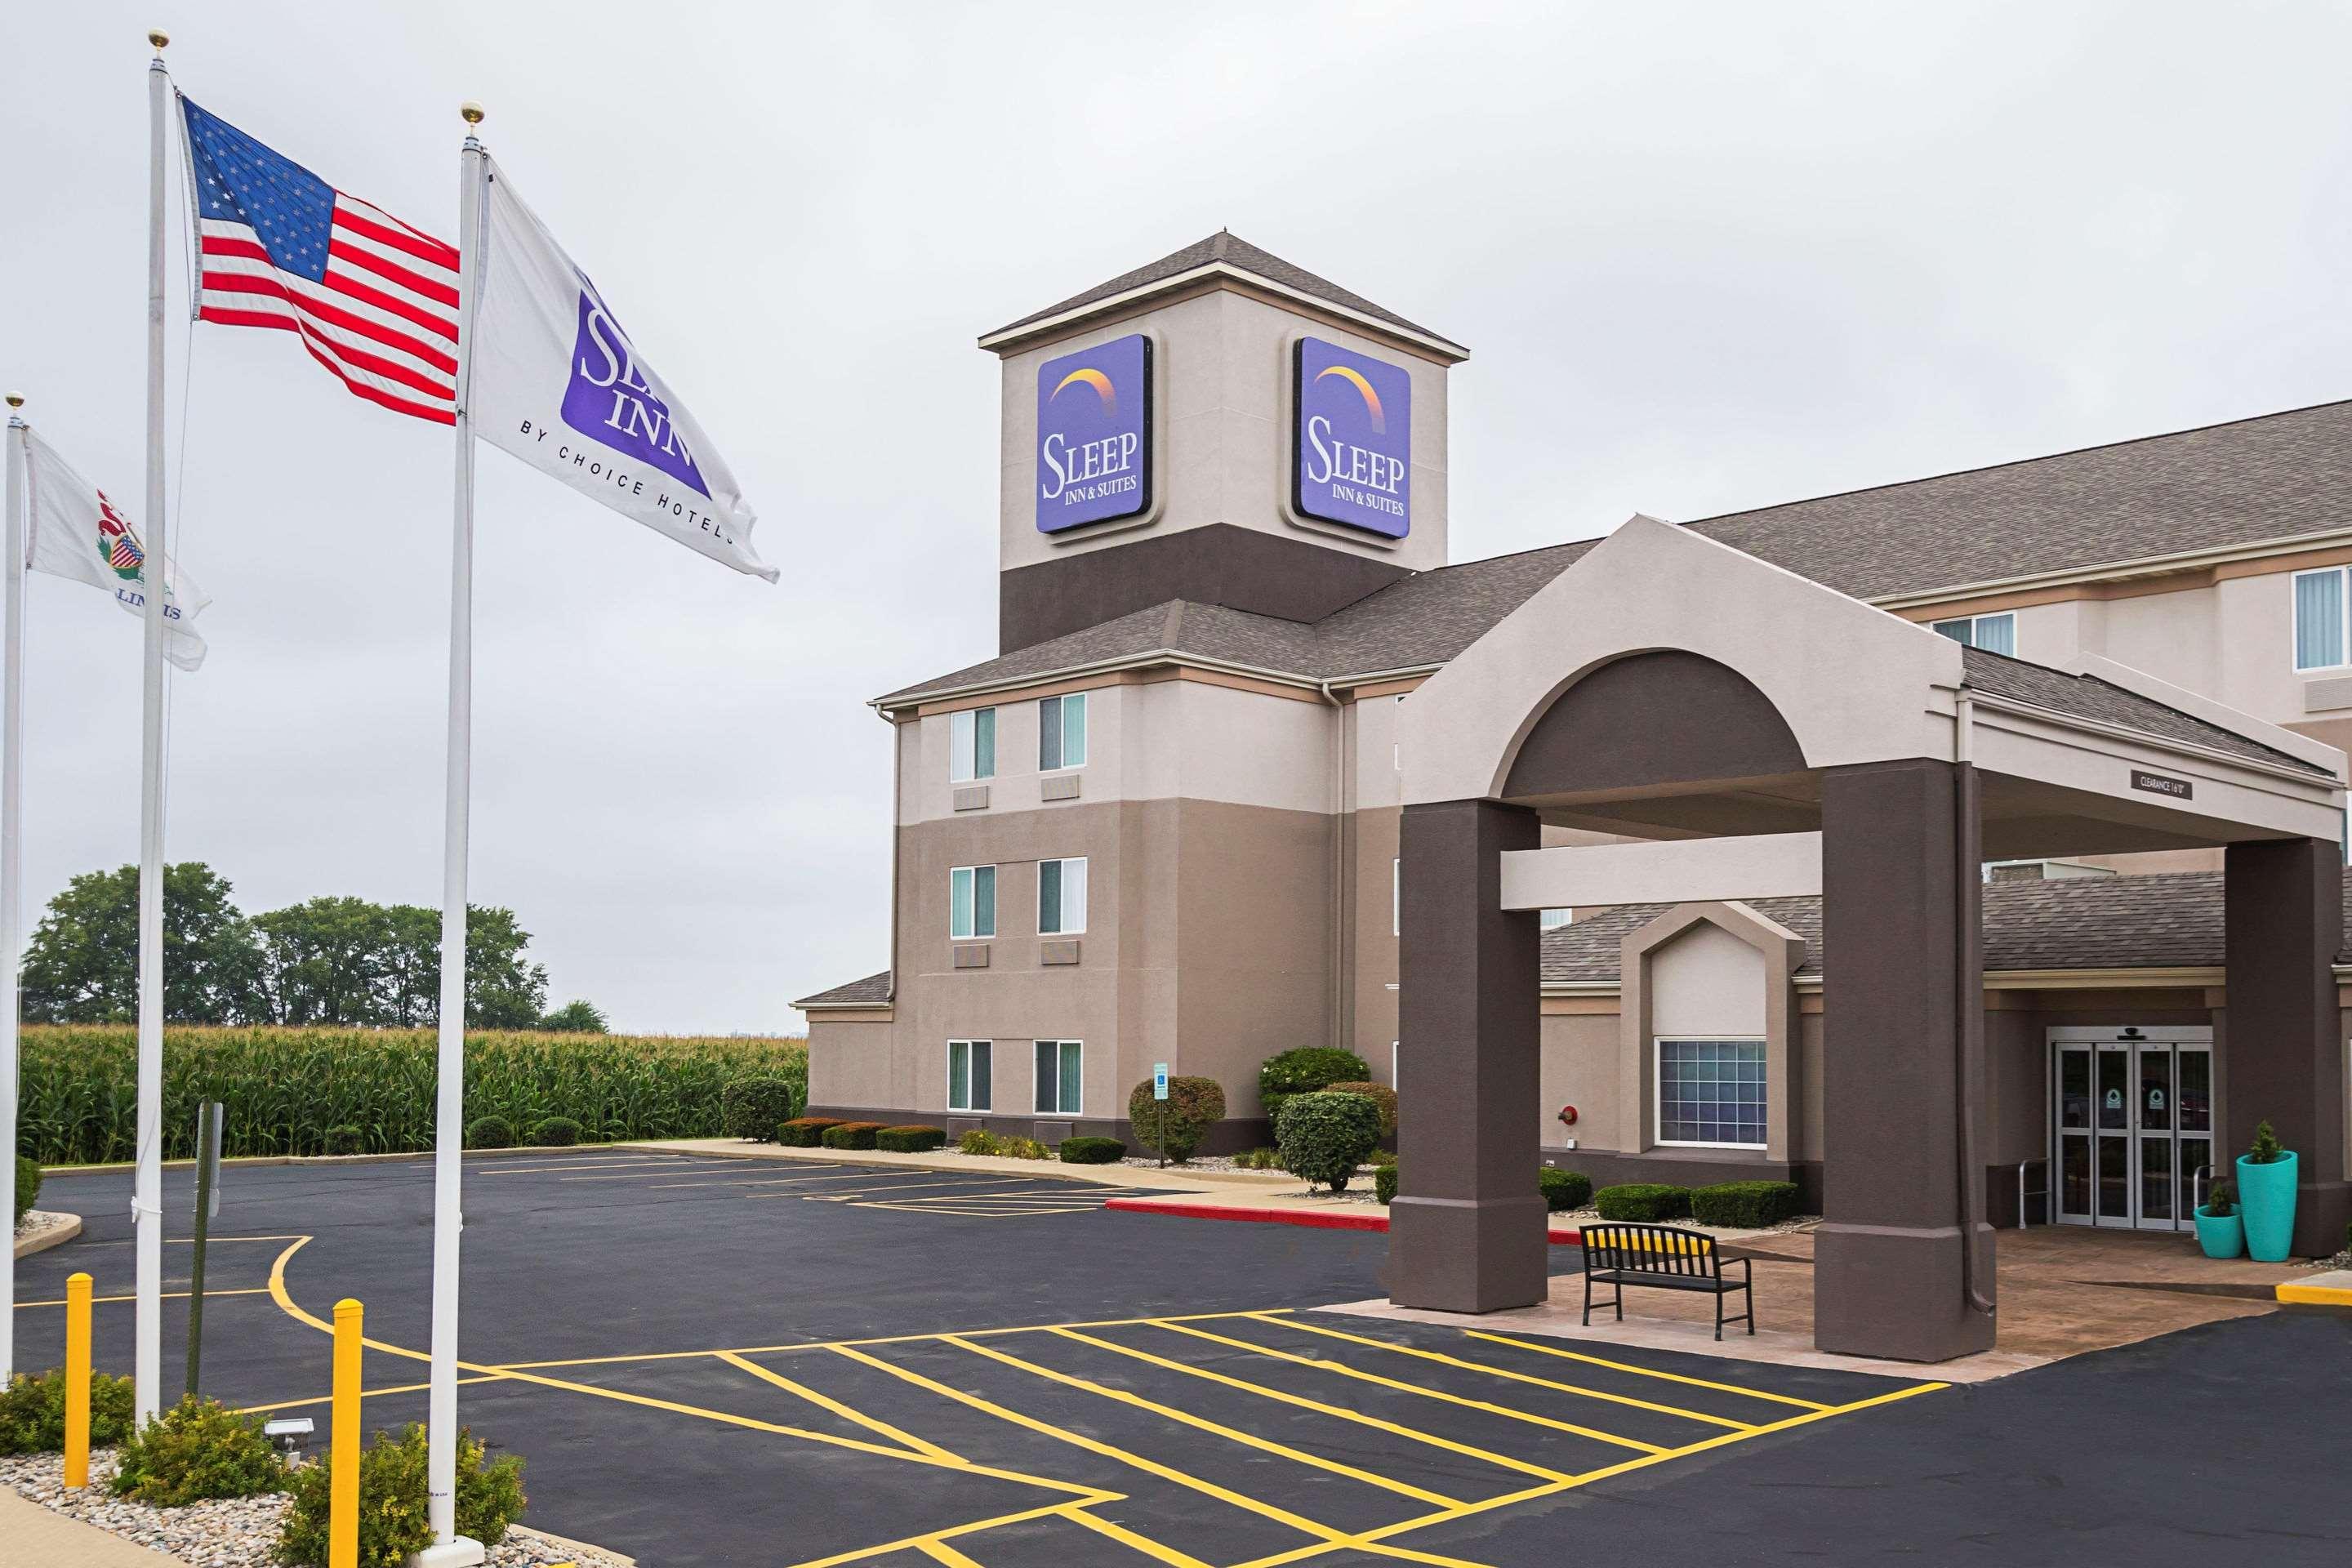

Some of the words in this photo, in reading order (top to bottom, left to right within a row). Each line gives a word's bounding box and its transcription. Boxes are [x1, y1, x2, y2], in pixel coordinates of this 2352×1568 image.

[581, 307, 659, 404] SL
[519, 420, 548, 443] BY
[559, 446, 644, 496] CHOICE
[604, 389, 692, 467] INN
[1307, 415, 1405, 495] SLEEP
[1042, 432, 1138, 500] SLEEP
[1064, 487, 1086, 506] INN
[1088, 486, 1096, 500] &
[1098, 474, 1137, 497] SUITES
[1332, 483, 1354, 503] INN
[1356, 491, 1365, 506] &
[1365, 492, 1405, 517] SUITES
[118, 588, 181, 620] LINIS
[2140, 777, 2170, 791] CLEARANCE
